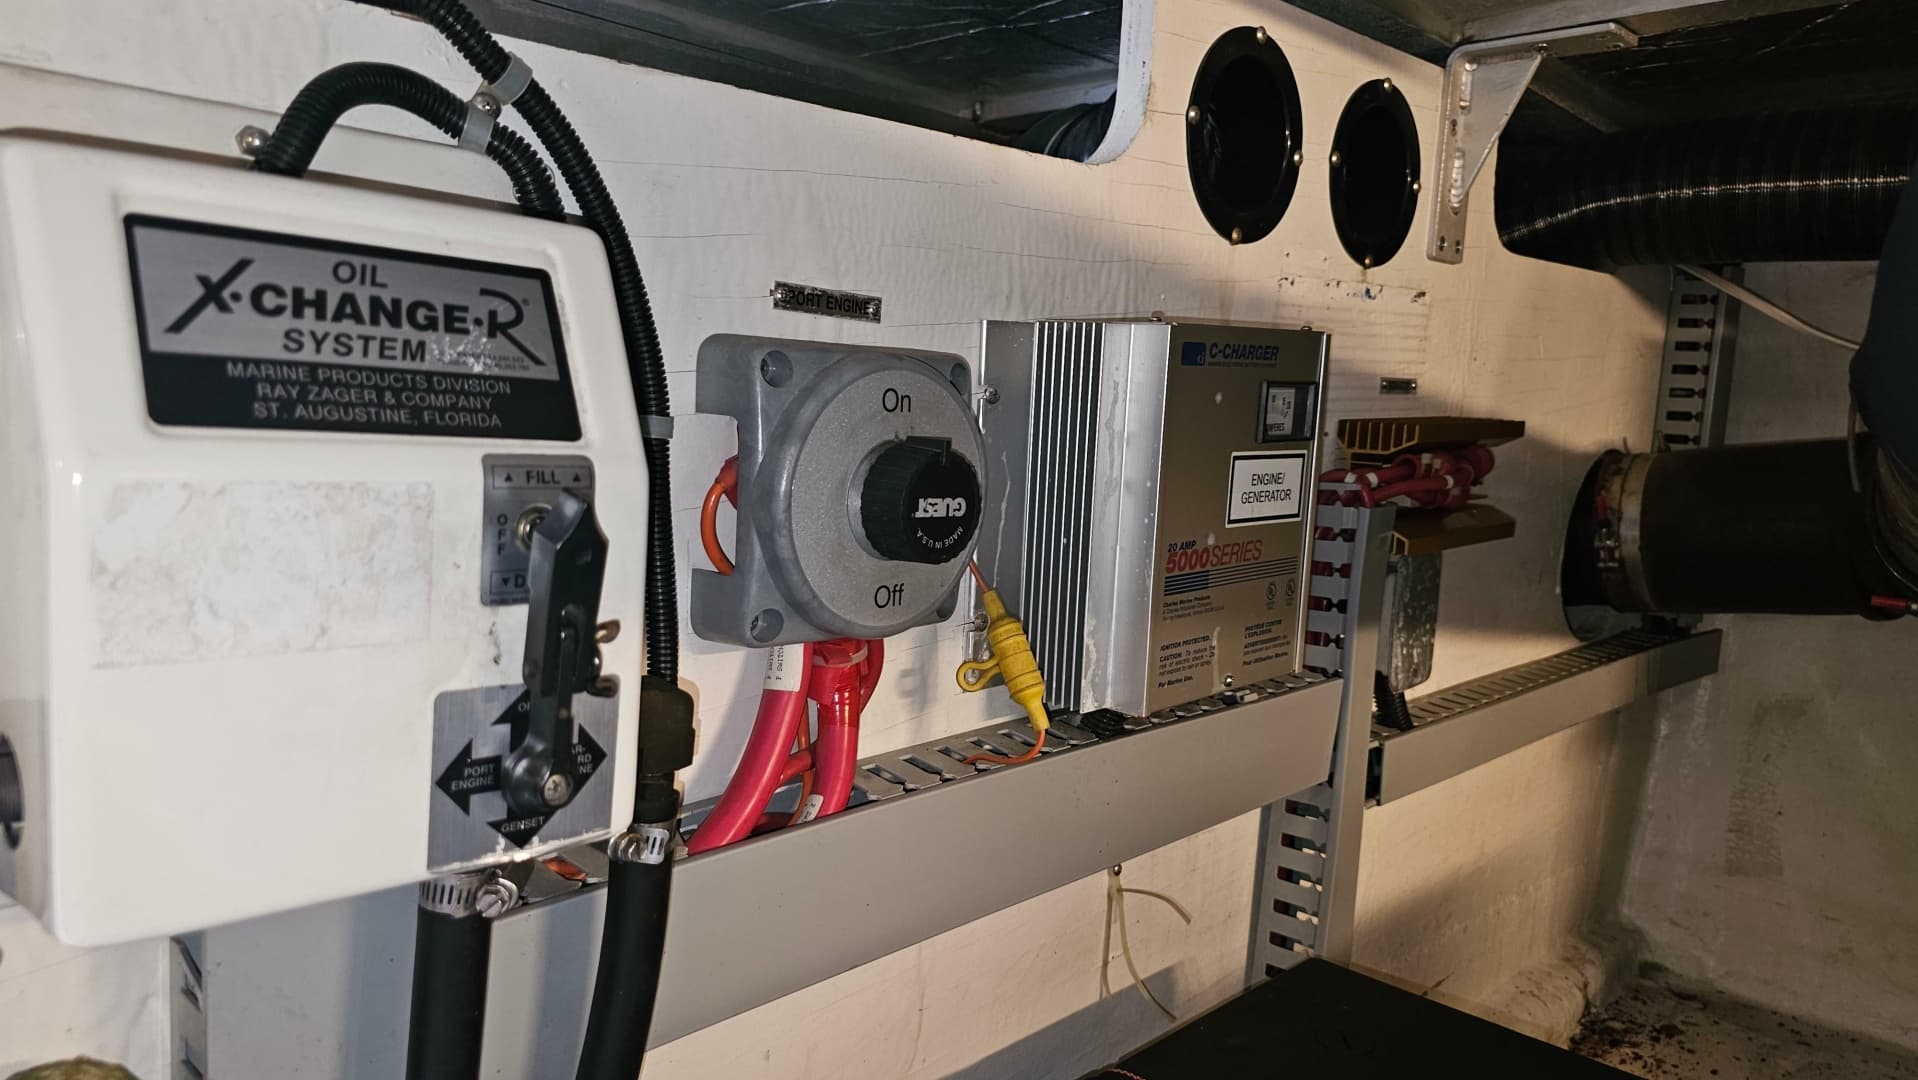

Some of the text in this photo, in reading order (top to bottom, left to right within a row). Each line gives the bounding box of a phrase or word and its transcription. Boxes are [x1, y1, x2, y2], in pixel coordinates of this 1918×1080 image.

[332, 260, 388, 288] OIL
[788, 289, 871, 315] PORT ENGINE
[282, 328, 427, 363] SYSTEM
[1209, 342, 1280, 361] C-CHARGER
[226, 360, 511, 394] MARINE PRODUCTS DIVISION
[256, 383, 492, 409] RAY ZAGER & COMPANY
[882, 388, 911, 413] On
[254, 402, 502, 428] ST. AUGUSTINE, FLORIDA
[526, 470, 560, 484] FILL
[1251, 472, 1286, 486] ENGINE/
[914, 497, 967, 518] GUEST
[1241, 488, 1292, 505] GENERATOR
[943, 525, 964, 548] MADE
[1168, 540, 1197, 552] 20 AMP
[874, 583, 905, 609] Off
[464, 764, 496, 778] PORT
[451, 774, 495, 791] ENGINE
[501, 816, 544, 833] GENSET
